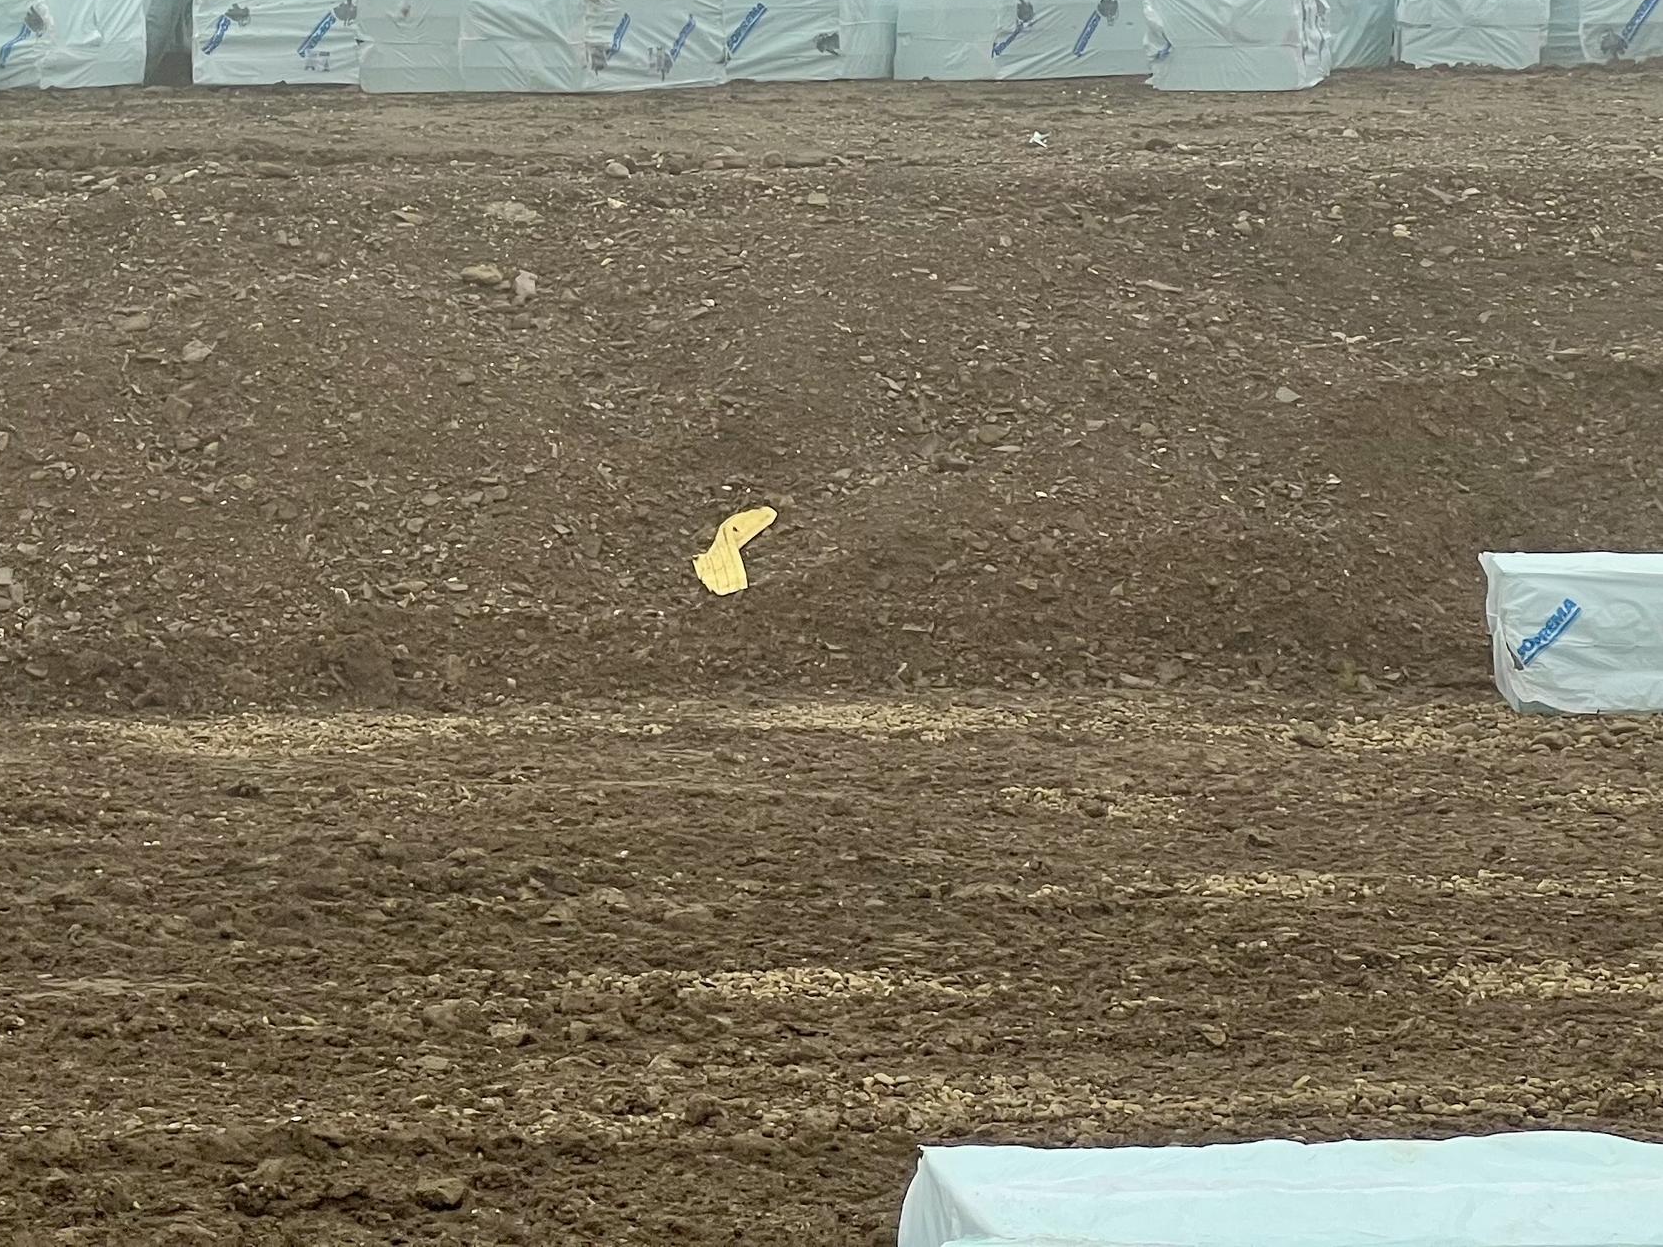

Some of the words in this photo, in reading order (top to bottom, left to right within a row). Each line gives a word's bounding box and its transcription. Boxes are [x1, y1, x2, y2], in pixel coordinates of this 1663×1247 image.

[299, 15, 336, 57] SOPREMA
[727, 3, 765, 51] SOPREMA
[1517, 598, 1577, 657] SOPREMA
